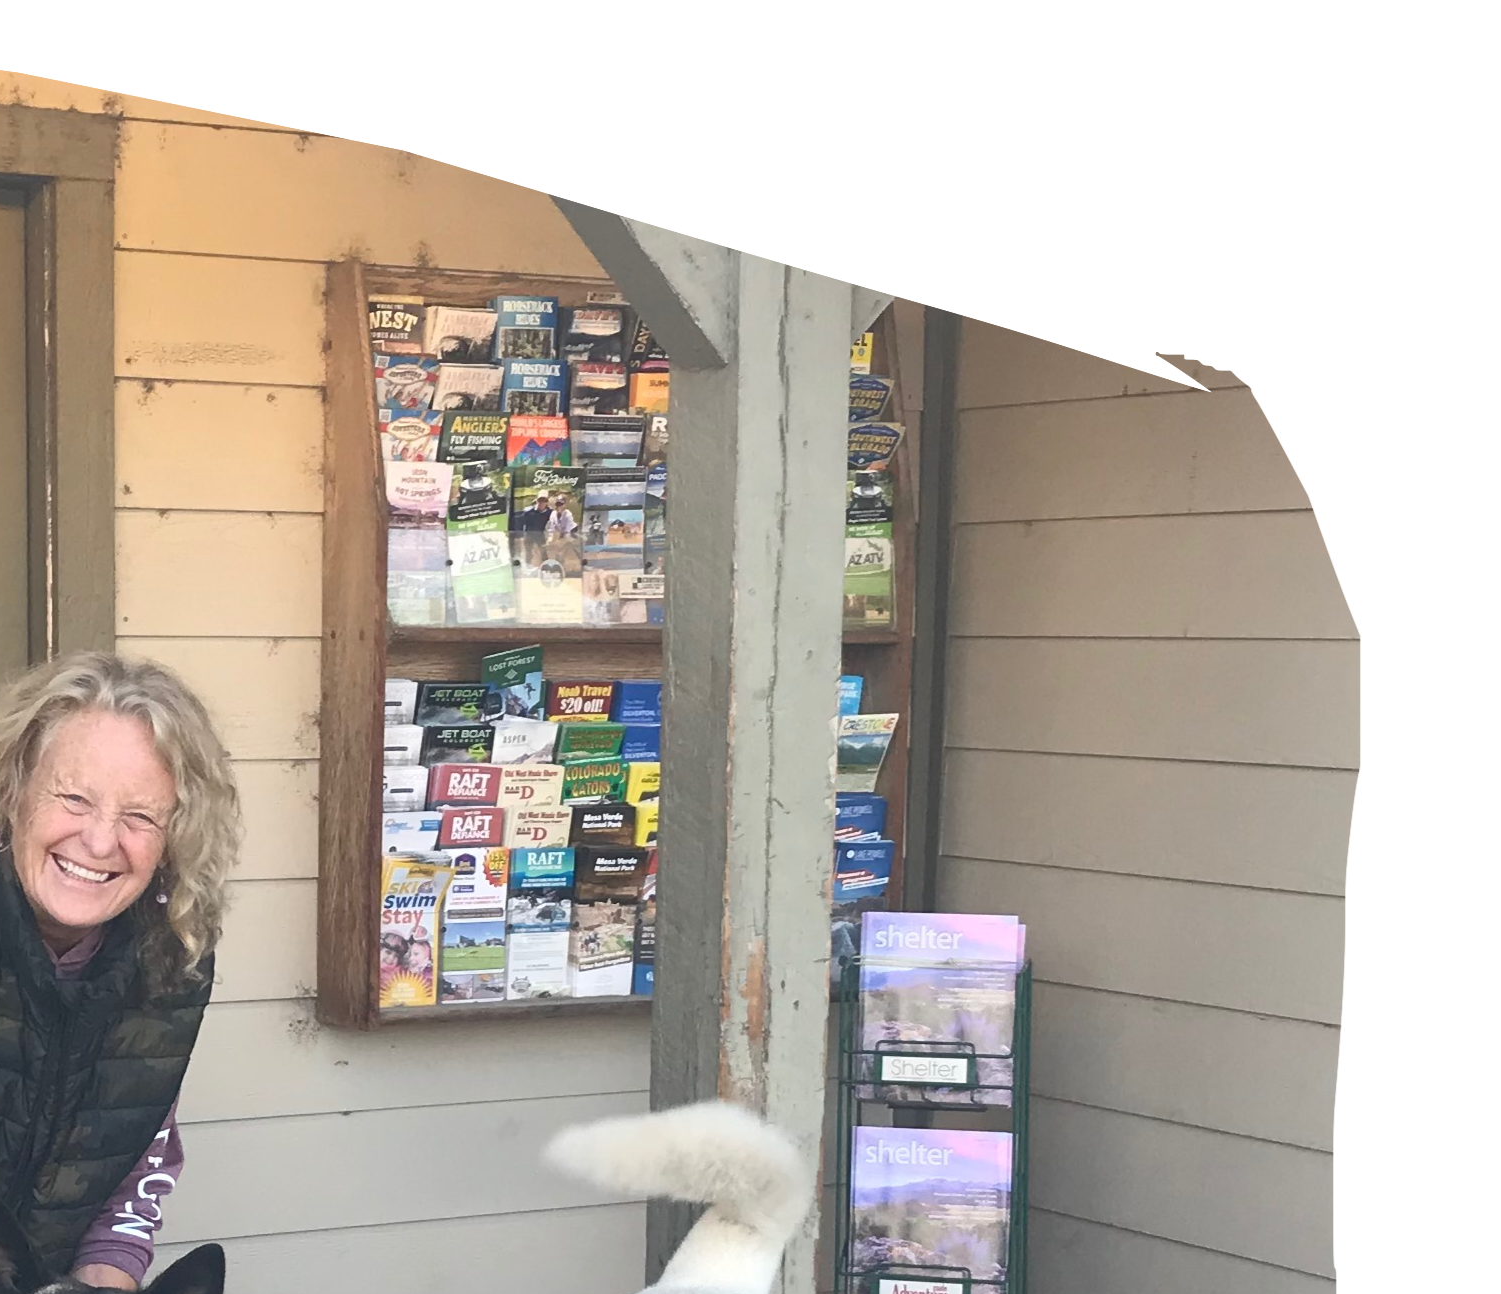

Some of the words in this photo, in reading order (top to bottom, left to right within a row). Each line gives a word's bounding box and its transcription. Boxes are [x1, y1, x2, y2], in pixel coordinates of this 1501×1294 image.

[502, 301, 554, 313] HORSEBACK
[515, 313, 541, 326] RIDES
[510, 362, 561, 377] HORSEBACK
[523, 376, 549, 388] RIDES
[450, 416, 508, 434] ANGLERS
[449, 435, 466, 445] FLY
[467, 435, 502, 445] FISHING
[401, 477, 437, 485] MOUNTAIN
[410, 488, 442, 498] SPRINGS
[462, 551, 477, 567] AZ
[848, 553, 862, 566] AZ
[863, 552, 885, 564] ATV
[489, 661, 507, 673] LOST
[507, 655, 536, 669] FOREST
[430, 689, 452, 698] JET
[453, 688, 486, 698] BOAT
[560, 697, 583, 714] $20
[584, 698, 605, 713] off!
[436, 729, 460, 739] JET
[460, 729, 492, 739] BOAT
[502, 734, 527, 745] ASPEN
[565, 763, 621, 781] COLORADO
[449, 772, 491, 789] RAFT
[447, 787, 487, 798] DEFIANCE
[571, 781, 611, 797] GATORS
[583, 814, 601, 822] Mesa
[602, 812, 624, 821] Verde
[452, 815, 493, 832] RAFT
[582, 821, 606, 829] National
[451, 830, 491, 840] DEFIANCE
[527, 851, 565, 866] RAFT
[596, 857, 616, 865] Mesa
[617, 857, 638, 865] Verde
[489, 861, 505, 870] OFF
[594, 864, 620, 872] National
[621, 864, 636, 872] Park
[874, 924, 964, 951] shelter
[890, 1057, 958, 1080] Shelter
[864, 1138, 954, 1167] shelter
